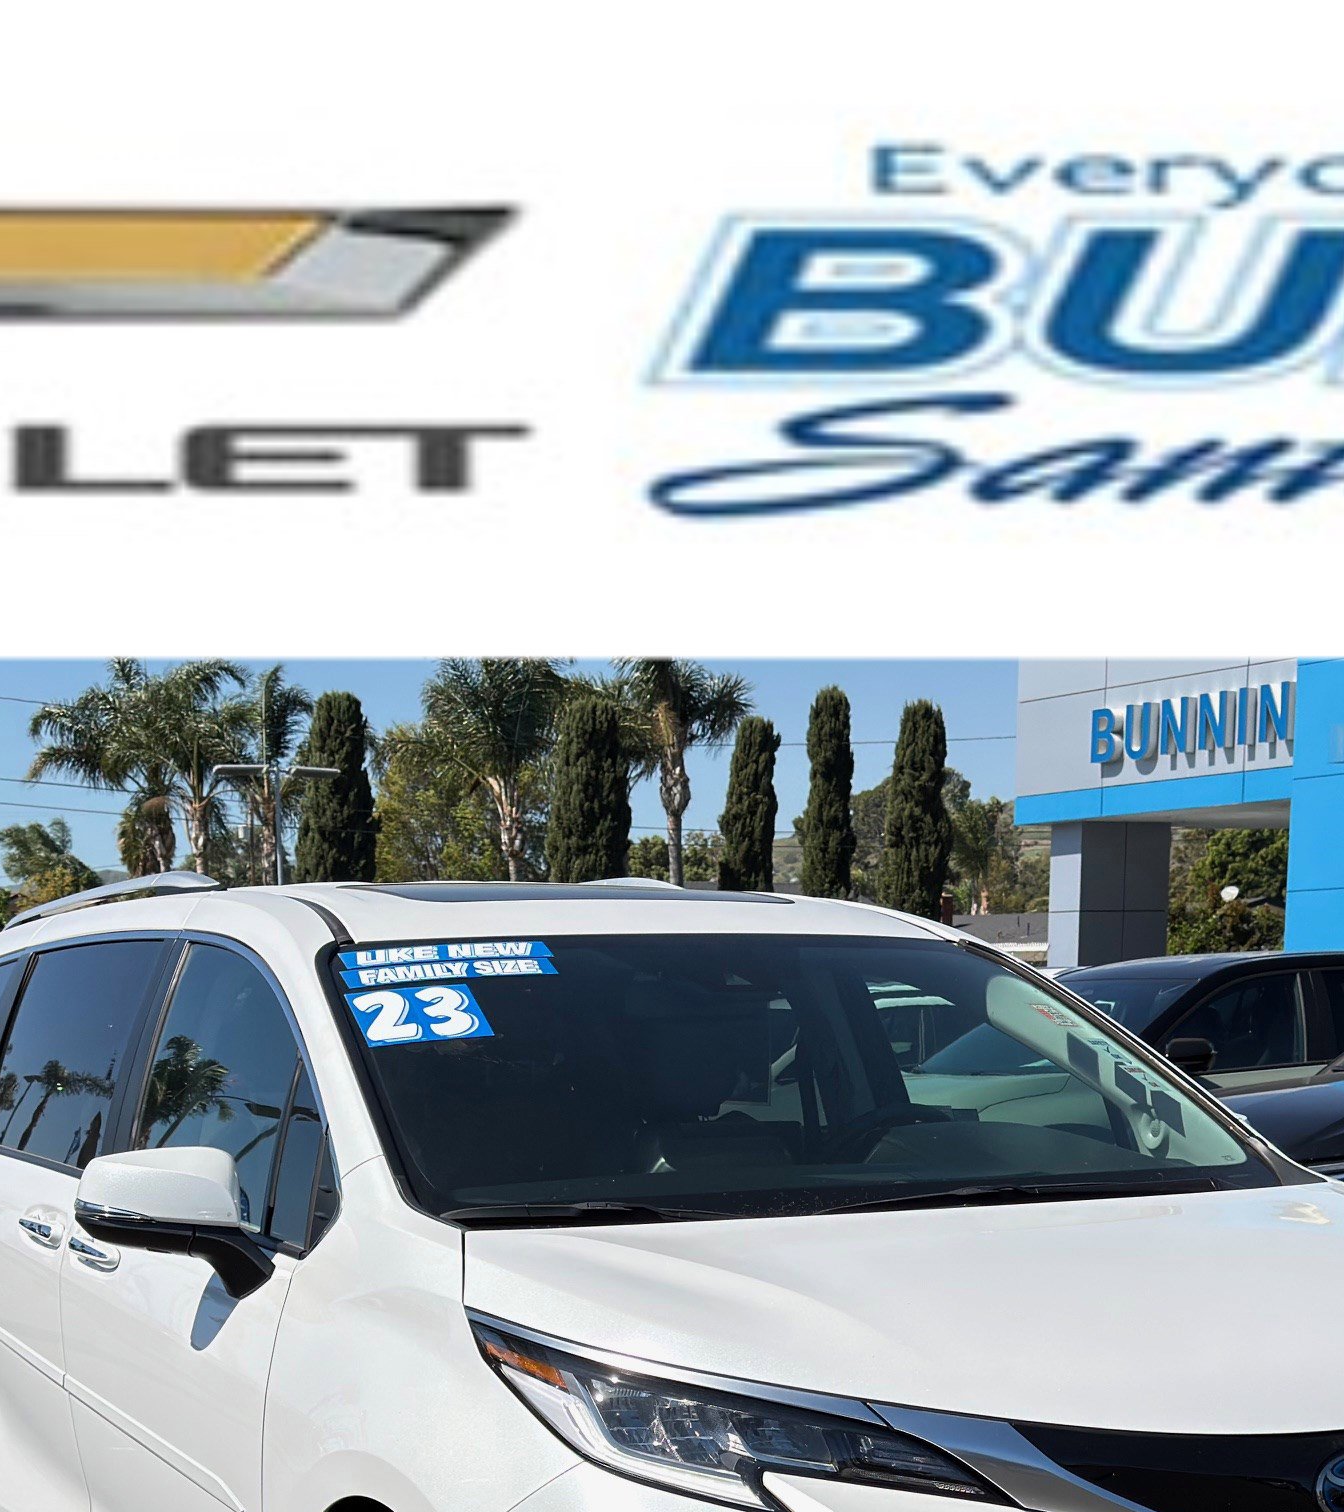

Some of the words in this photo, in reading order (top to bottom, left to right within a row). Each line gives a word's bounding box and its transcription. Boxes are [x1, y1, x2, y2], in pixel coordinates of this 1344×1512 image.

[1090, 680, 1296, 765] BUNNIN
[355, 947, 440, 966] LIKE
[448, 941, 533, 959] NEW
[357, 961, 469, 986] FAMILY
[474, 957, 543, 976] SIZE
[351, 984, 481, 1042] 23
